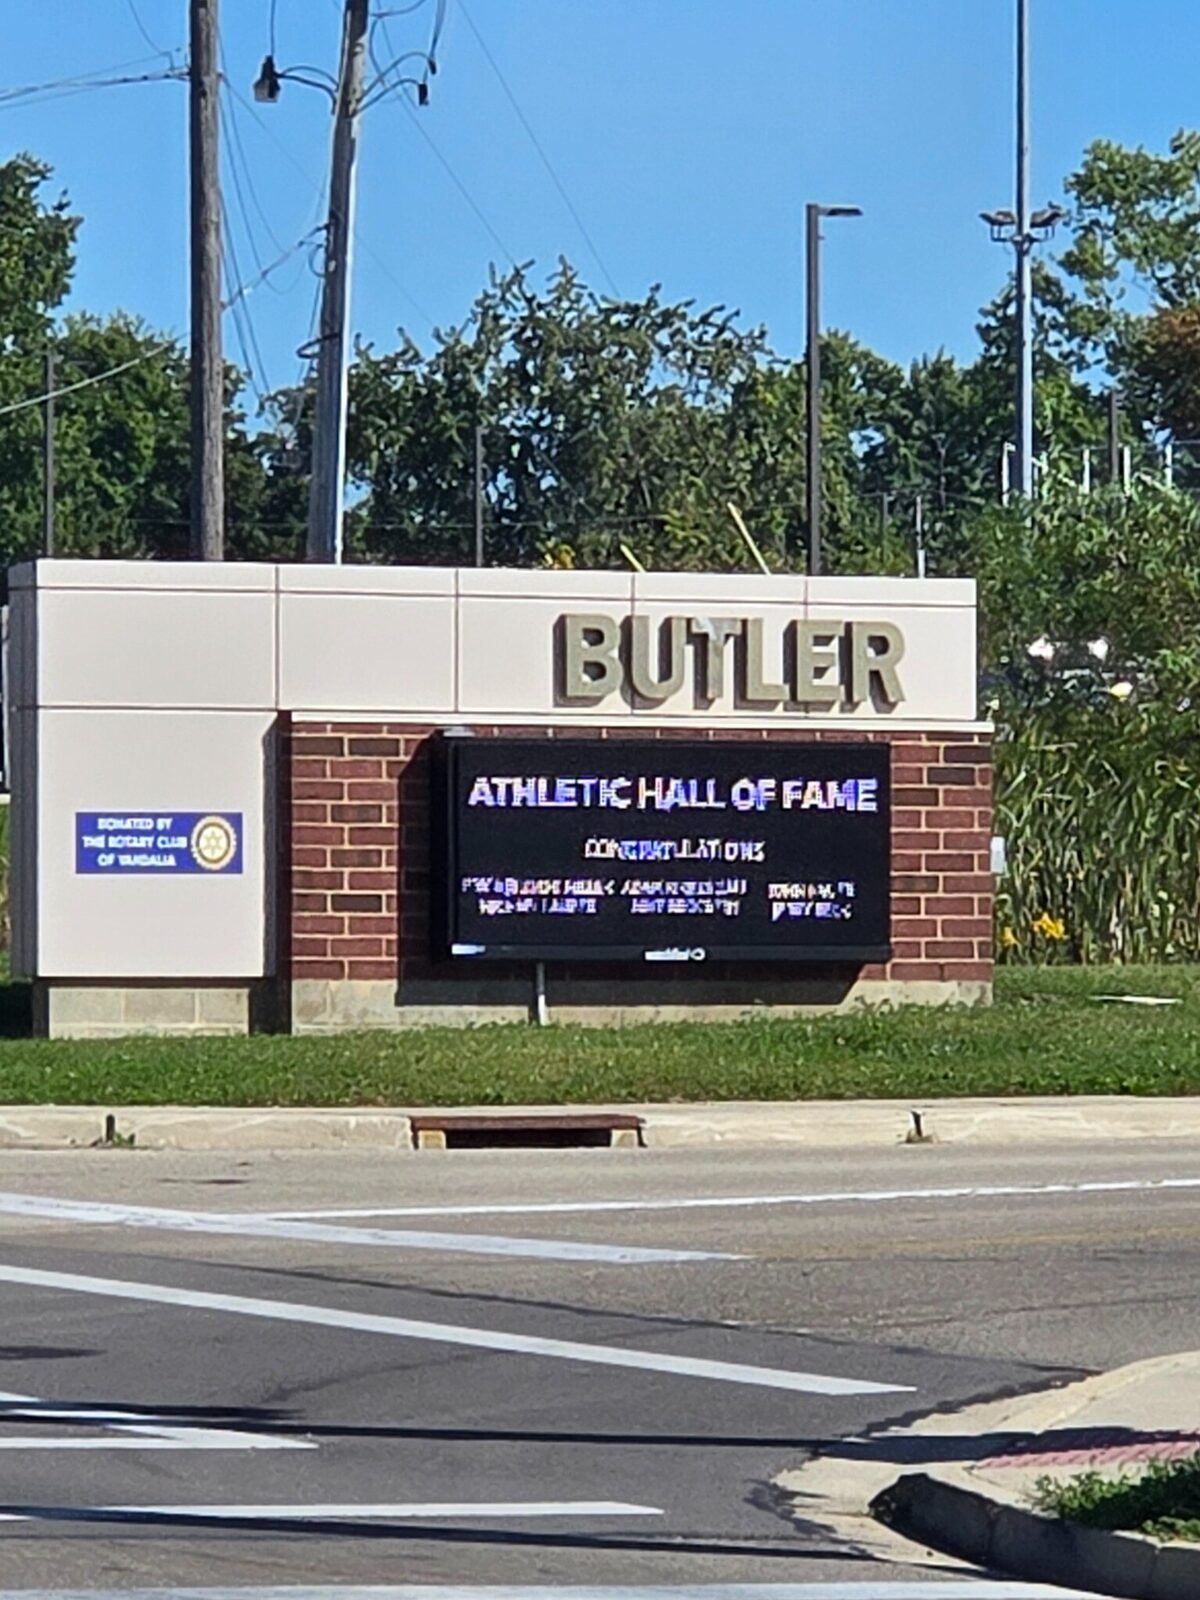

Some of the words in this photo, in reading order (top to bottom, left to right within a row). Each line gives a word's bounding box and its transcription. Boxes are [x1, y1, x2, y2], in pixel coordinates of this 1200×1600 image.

[555, 612, 906, 712] BUTLER
[467, 776, 633, 811] ATHLETIC
[638, 777, 726, 813] HALL
[731, 777, 777, 812] OF
[782, 777, 878, 813] FAME
[156, 817, 173, 831] BY
[97, 853, 115, 866] OF
